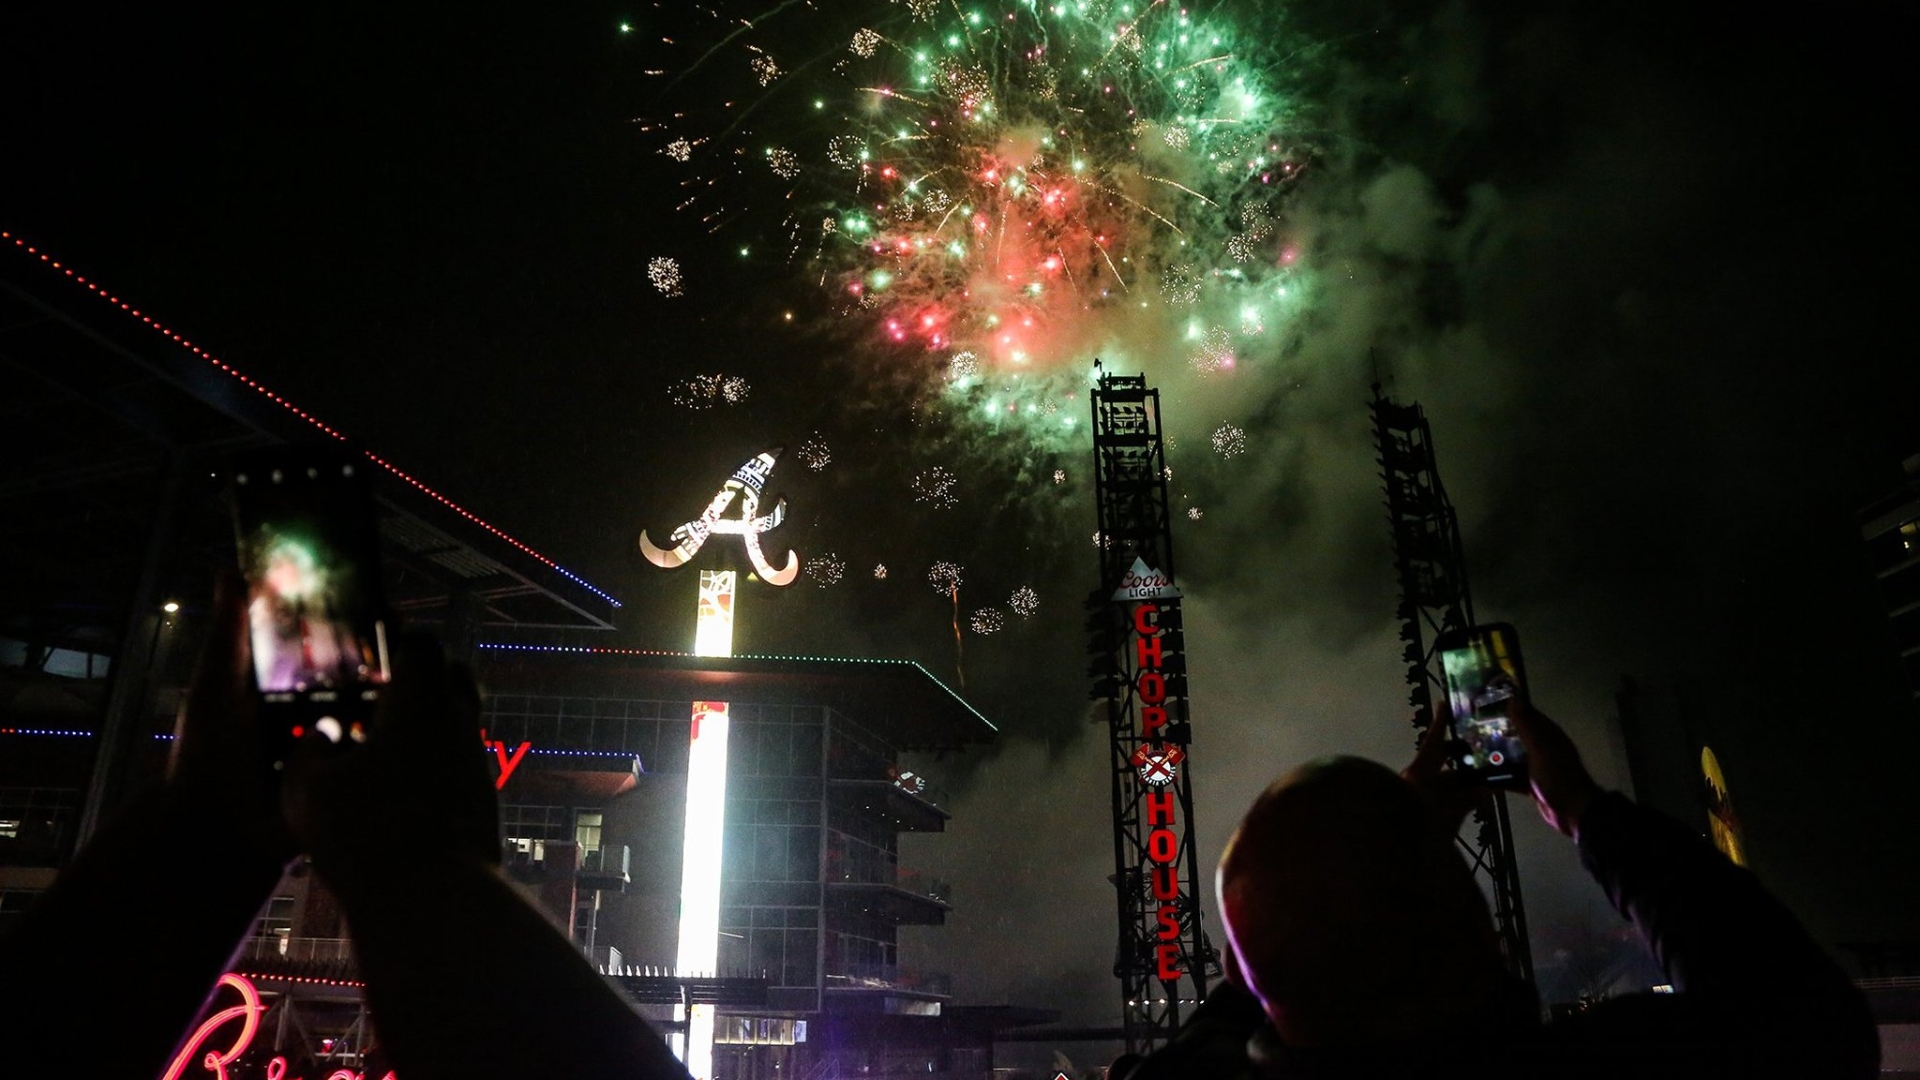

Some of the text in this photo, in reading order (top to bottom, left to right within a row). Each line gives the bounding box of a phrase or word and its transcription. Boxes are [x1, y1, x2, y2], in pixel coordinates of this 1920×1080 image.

[1120, 570, 1171, 589] Coors
[1129, 587, 1162, 598] LIGHT
[1134, 603, 1182, 980] CHOP HOUSE
